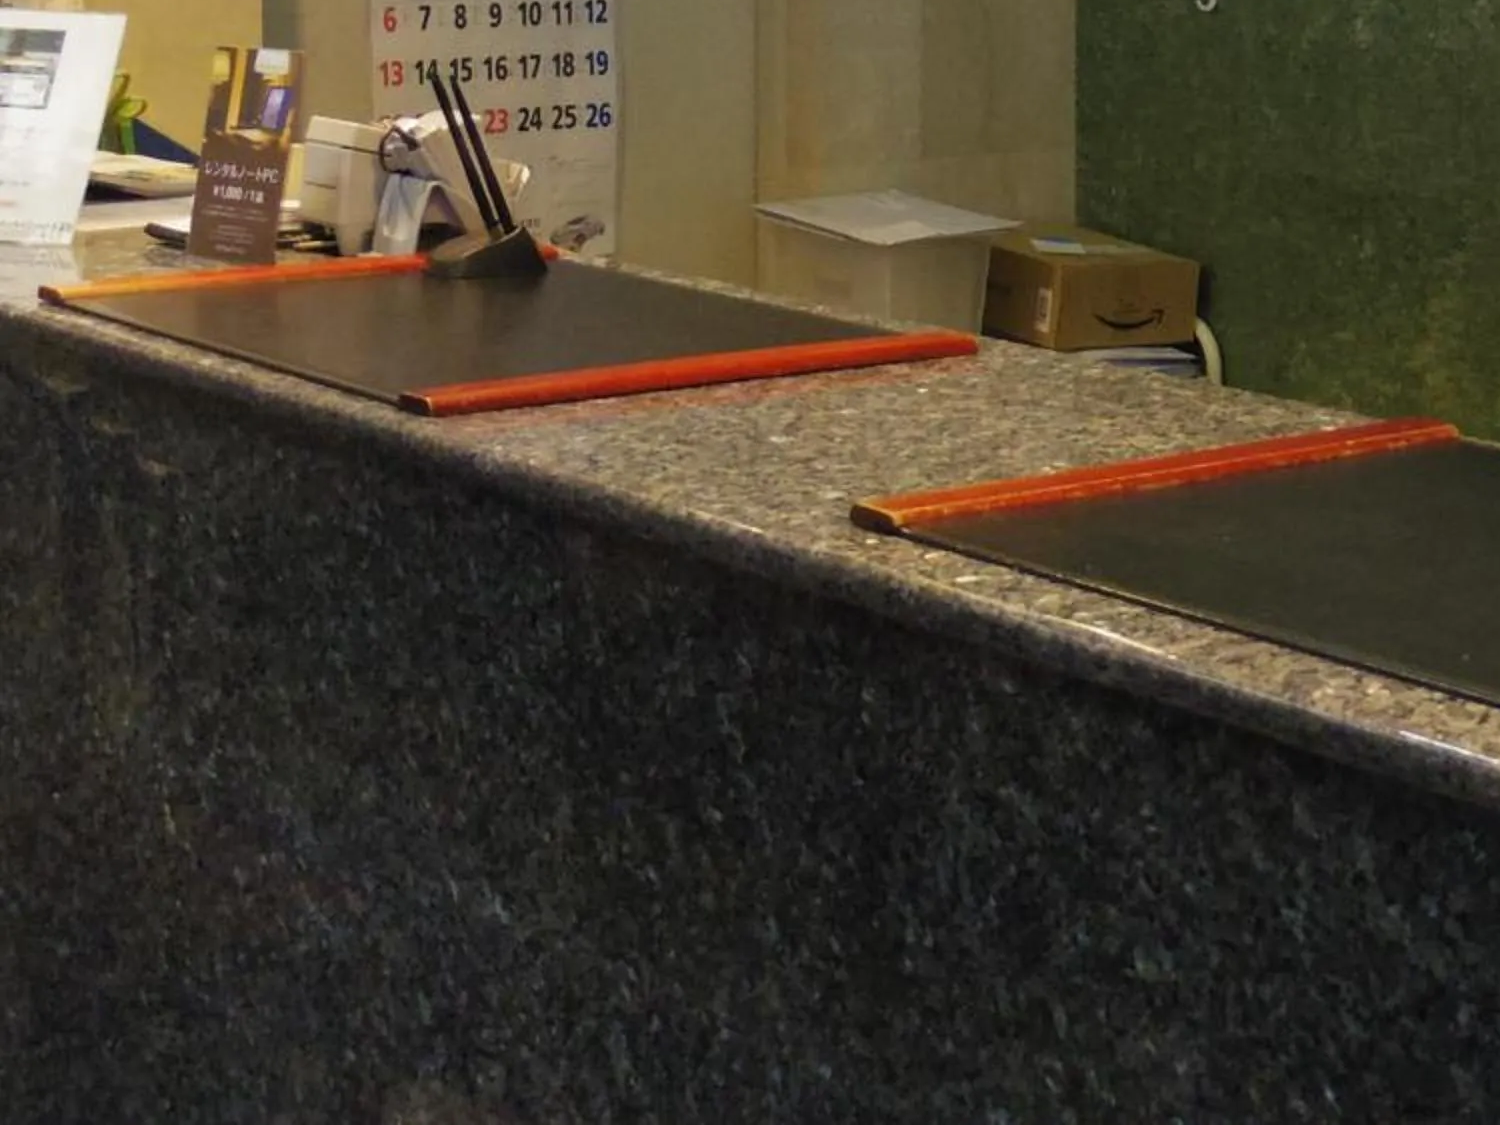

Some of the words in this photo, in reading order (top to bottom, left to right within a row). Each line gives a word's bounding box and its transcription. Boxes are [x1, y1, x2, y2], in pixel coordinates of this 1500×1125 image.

[383, 6, 398, 33] 6
[418, 4, 431, 31] 7
[454, 3, 467, 30] 8
[489, 2, 502, 28] 9
[517, 1, 542, 27] 10
[551, 0, 573, 26] 11
[379, 60, 404, 88] 13
[415, 58, 439, 84] 14
[448, 56, 473, 83] 15
[483, 55, 509, 81] 16
[517, 53, 541, 80] 17
[552, 51, 575, 78] 18
[584, 50, 609, 76] 19
[484, 108, 509, 134] 23
[517, 106, 543, 132] 24
[551, 104, 577, 130] 25
[585, 102, 612, 128] 26
